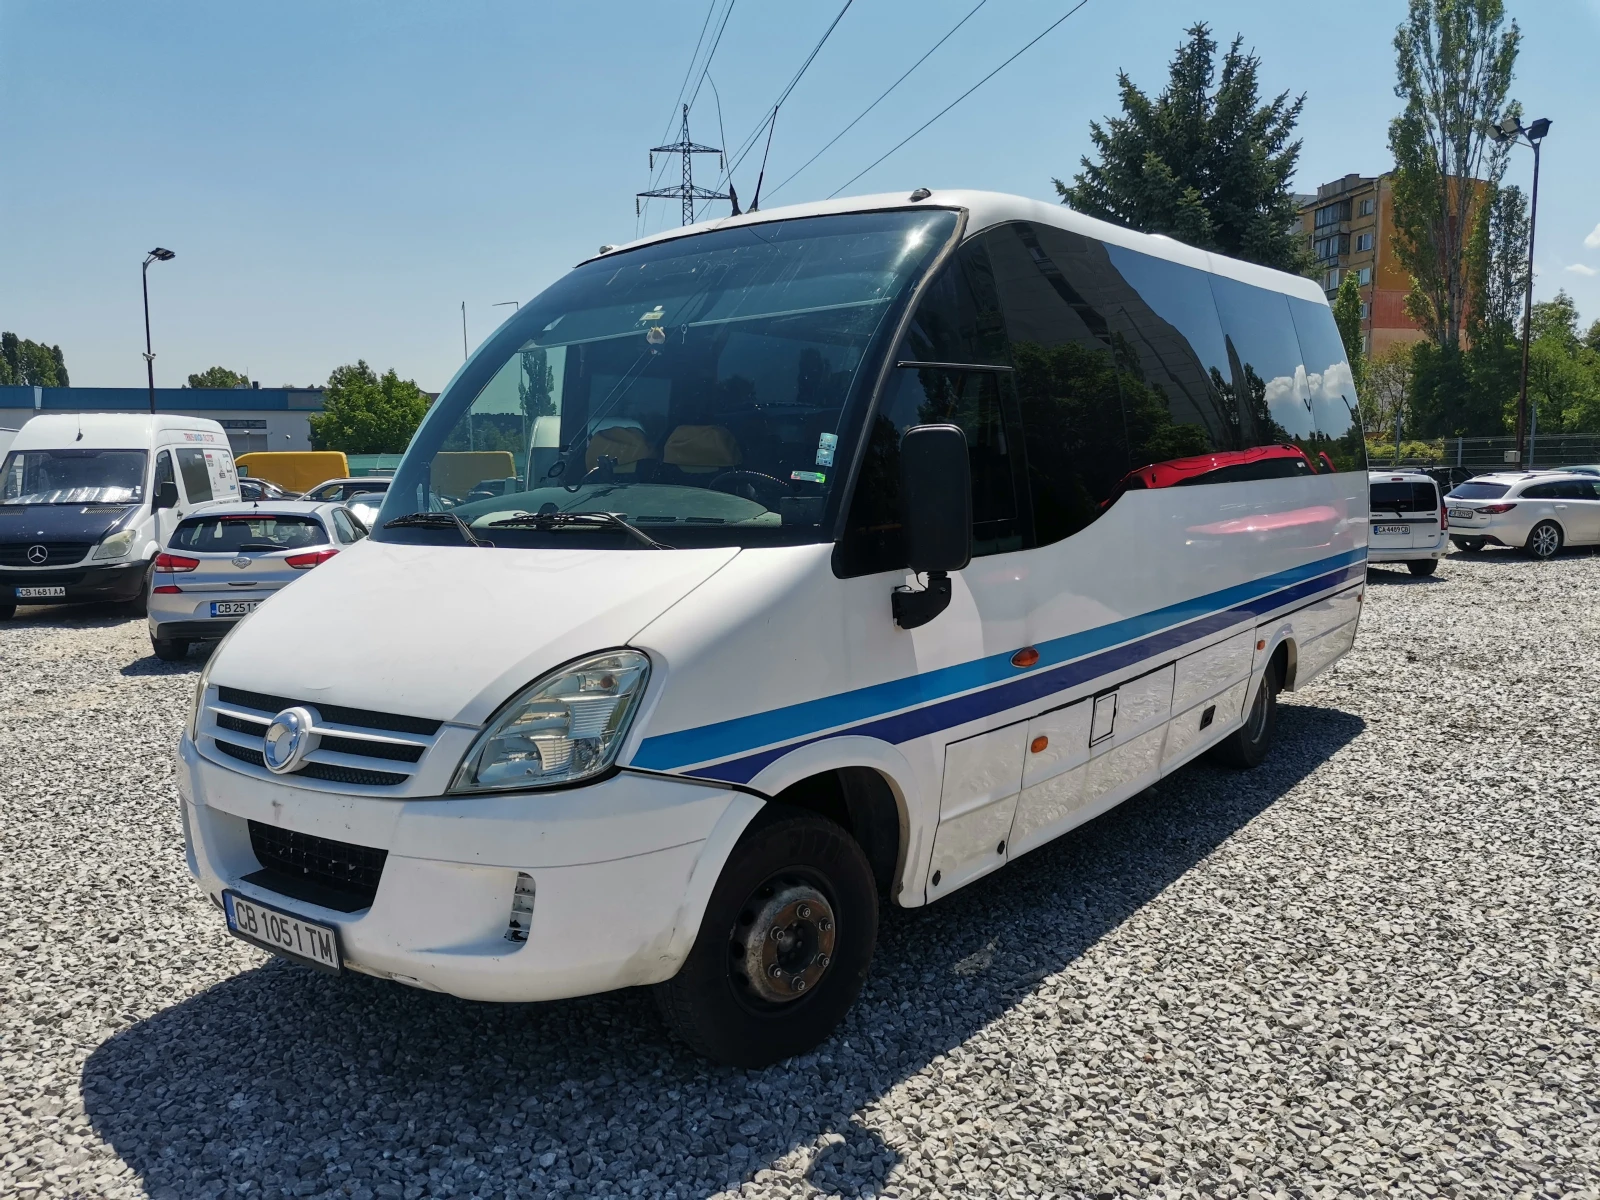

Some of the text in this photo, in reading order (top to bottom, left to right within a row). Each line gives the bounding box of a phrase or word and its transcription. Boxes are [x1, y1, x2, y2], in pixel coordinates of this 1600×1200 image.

[218, 603, 231, 613] CB
[236, 902, 333, 963] CB 1051 TM
